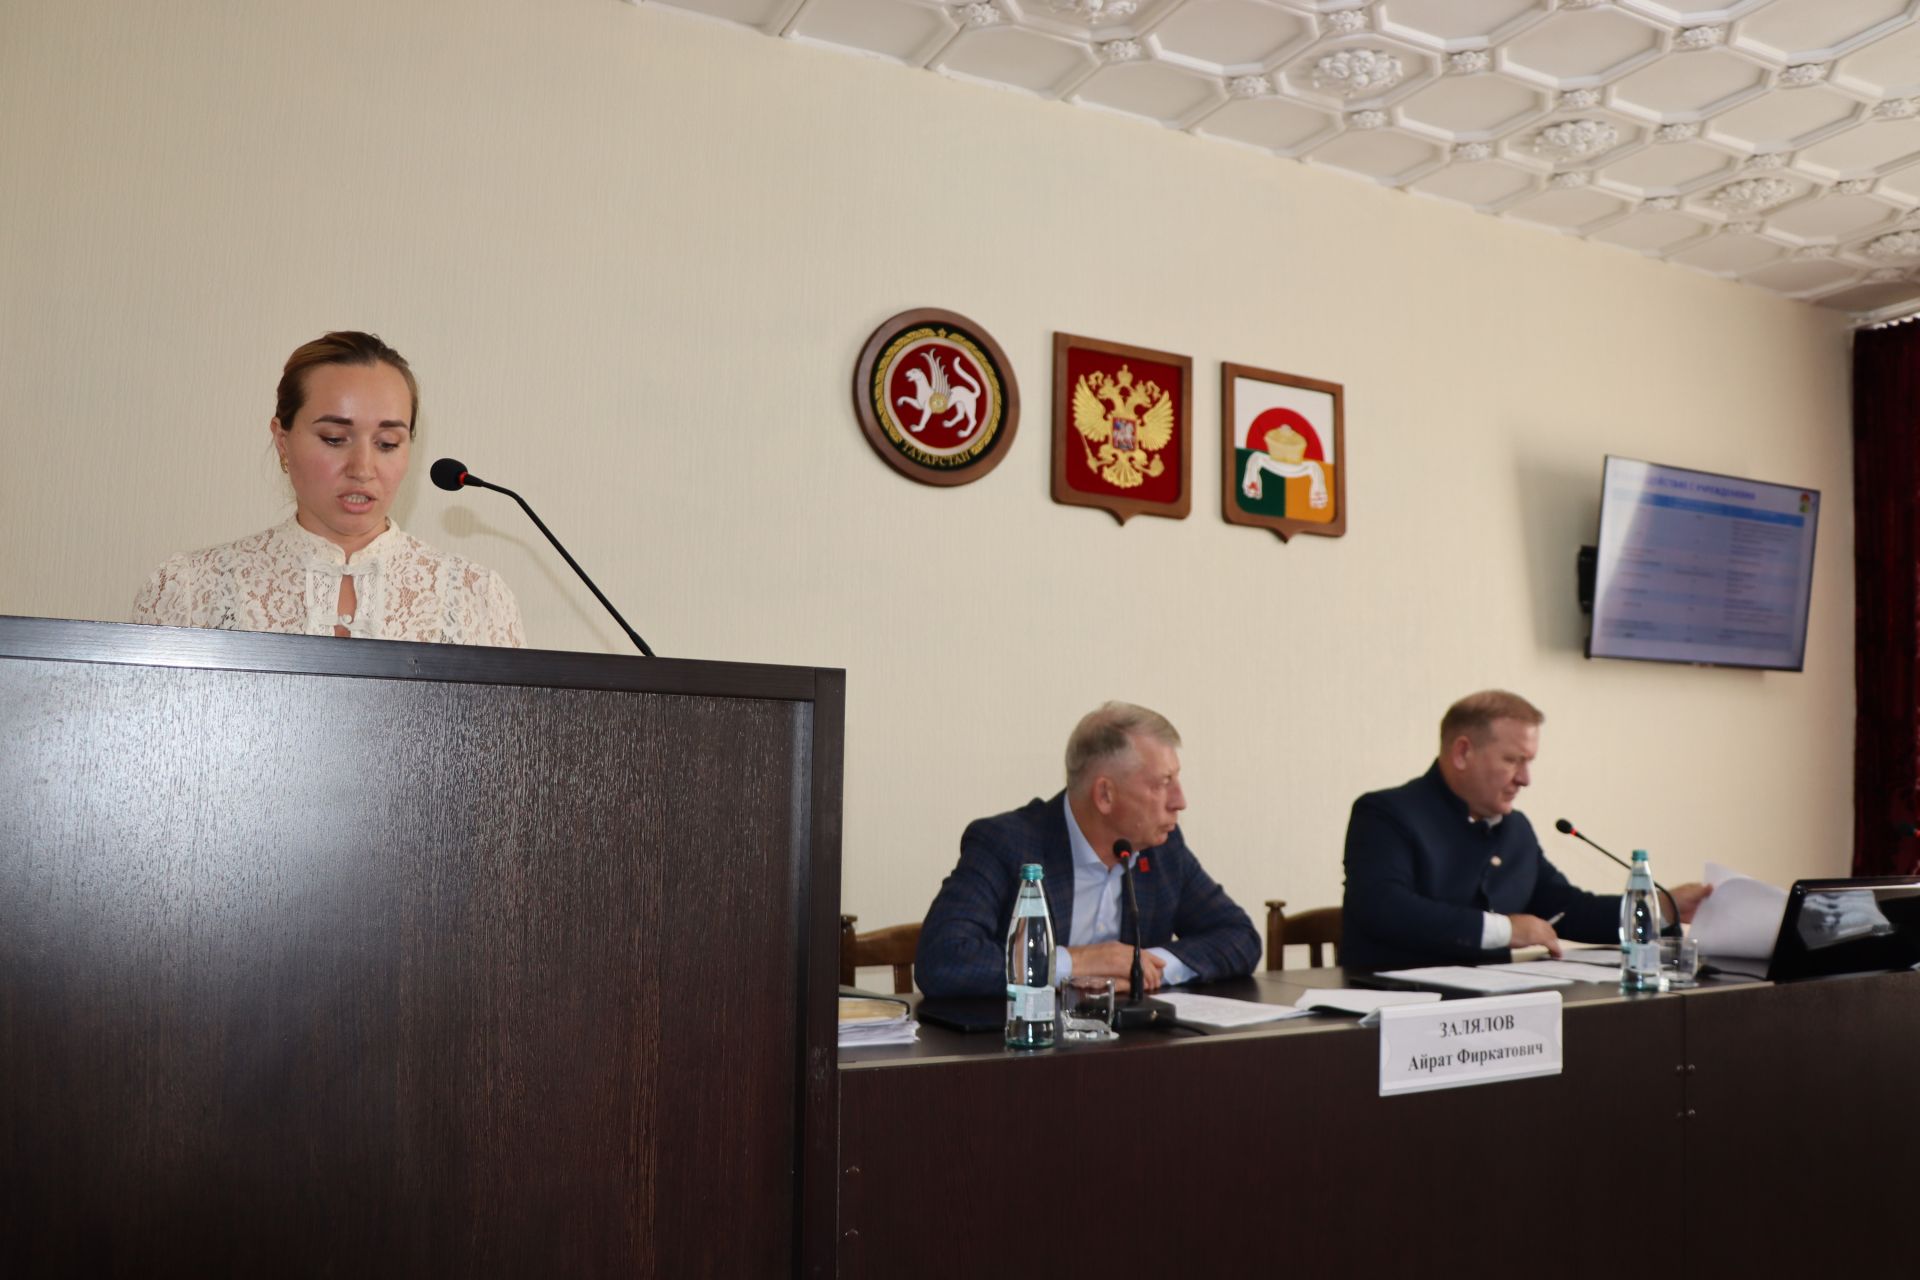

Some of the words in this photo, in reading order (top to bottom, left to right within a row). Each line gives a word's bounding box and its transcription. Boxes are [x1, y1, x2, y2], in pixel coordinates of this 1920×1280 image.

[903, 442, 971, 465] ТАТАРСТАН
[1440, 1015, 1514, 1037] ЗАЛЯЛОВ
[1409, 1053, 1453, 1072] Айрат
[1457, 1044, 1543, 1065] Фиркатович
